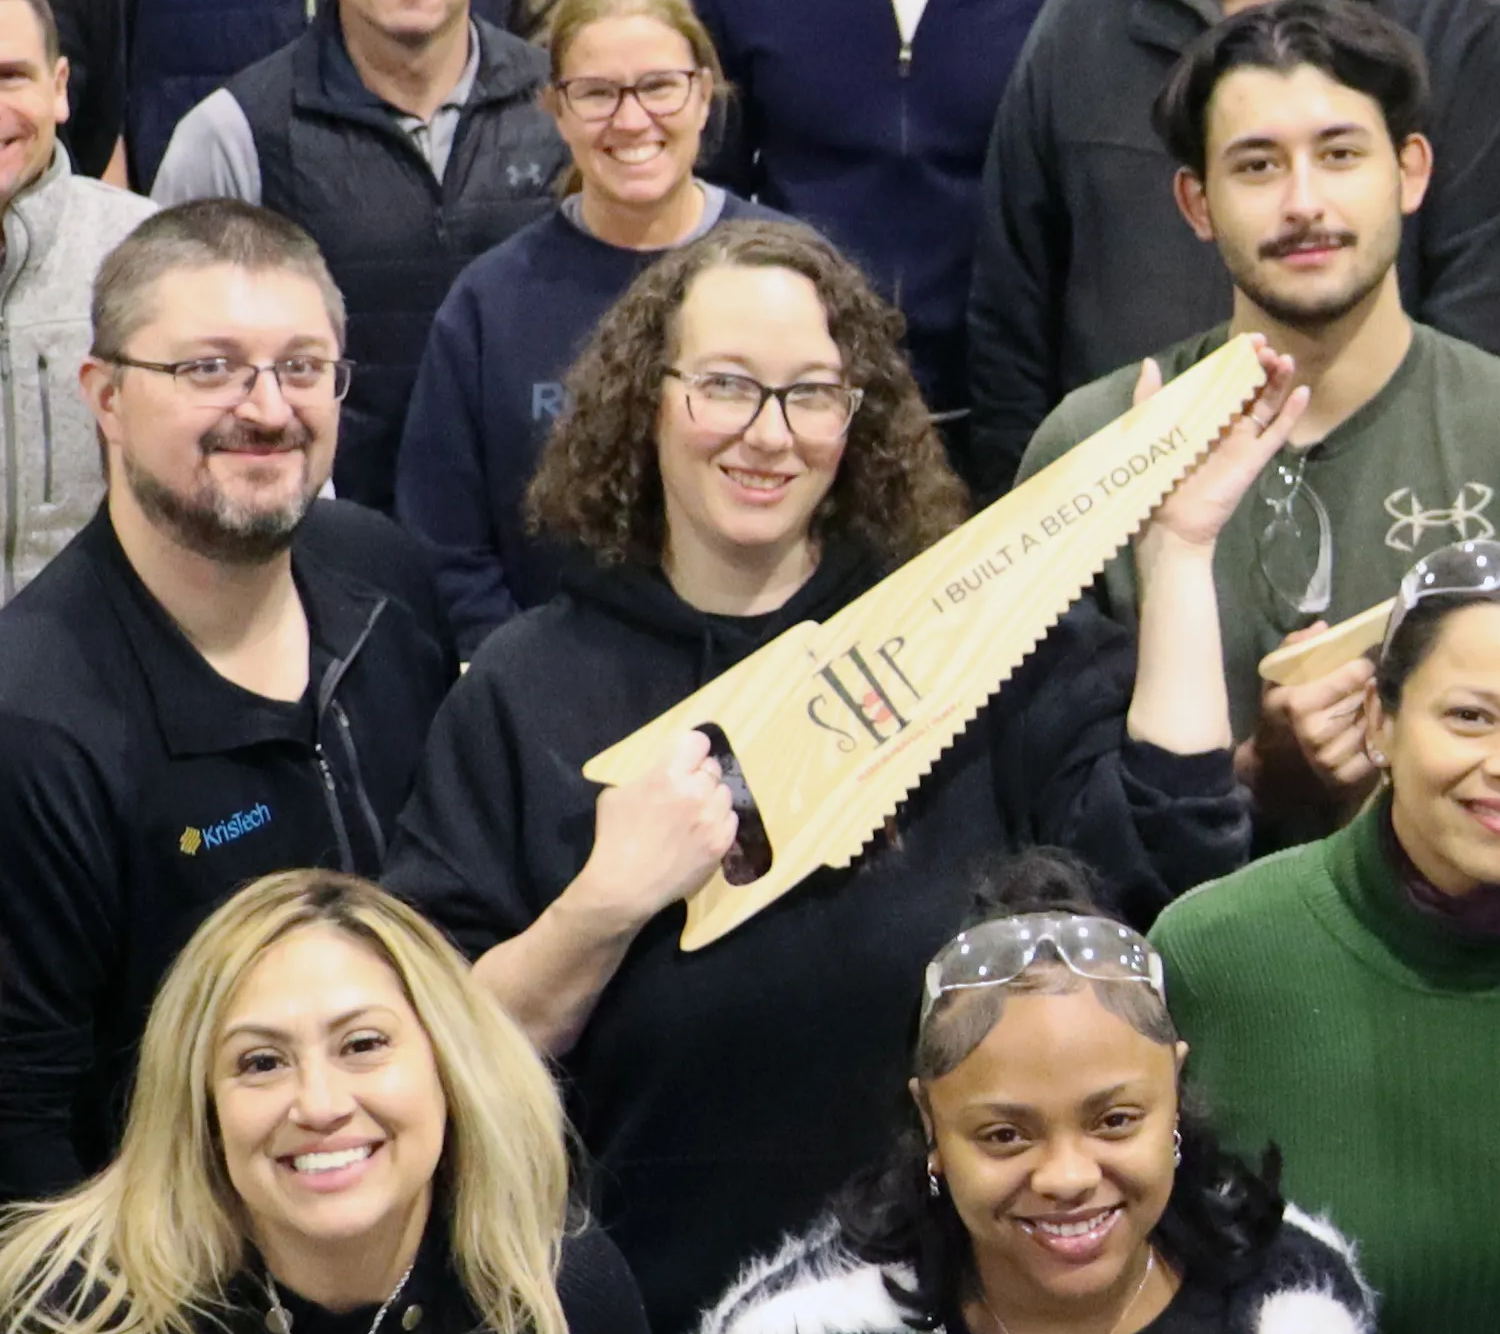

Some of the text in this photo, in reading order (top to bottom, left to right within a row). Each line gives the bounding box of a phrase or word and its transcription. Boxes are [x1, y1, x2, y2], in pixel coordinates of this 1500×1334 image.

[931, 426, 1188, 613] I BUILT A BED TODAY!
[807, 635, 923, 753] SHP
[202, 802, 272, 850] KrisTech
